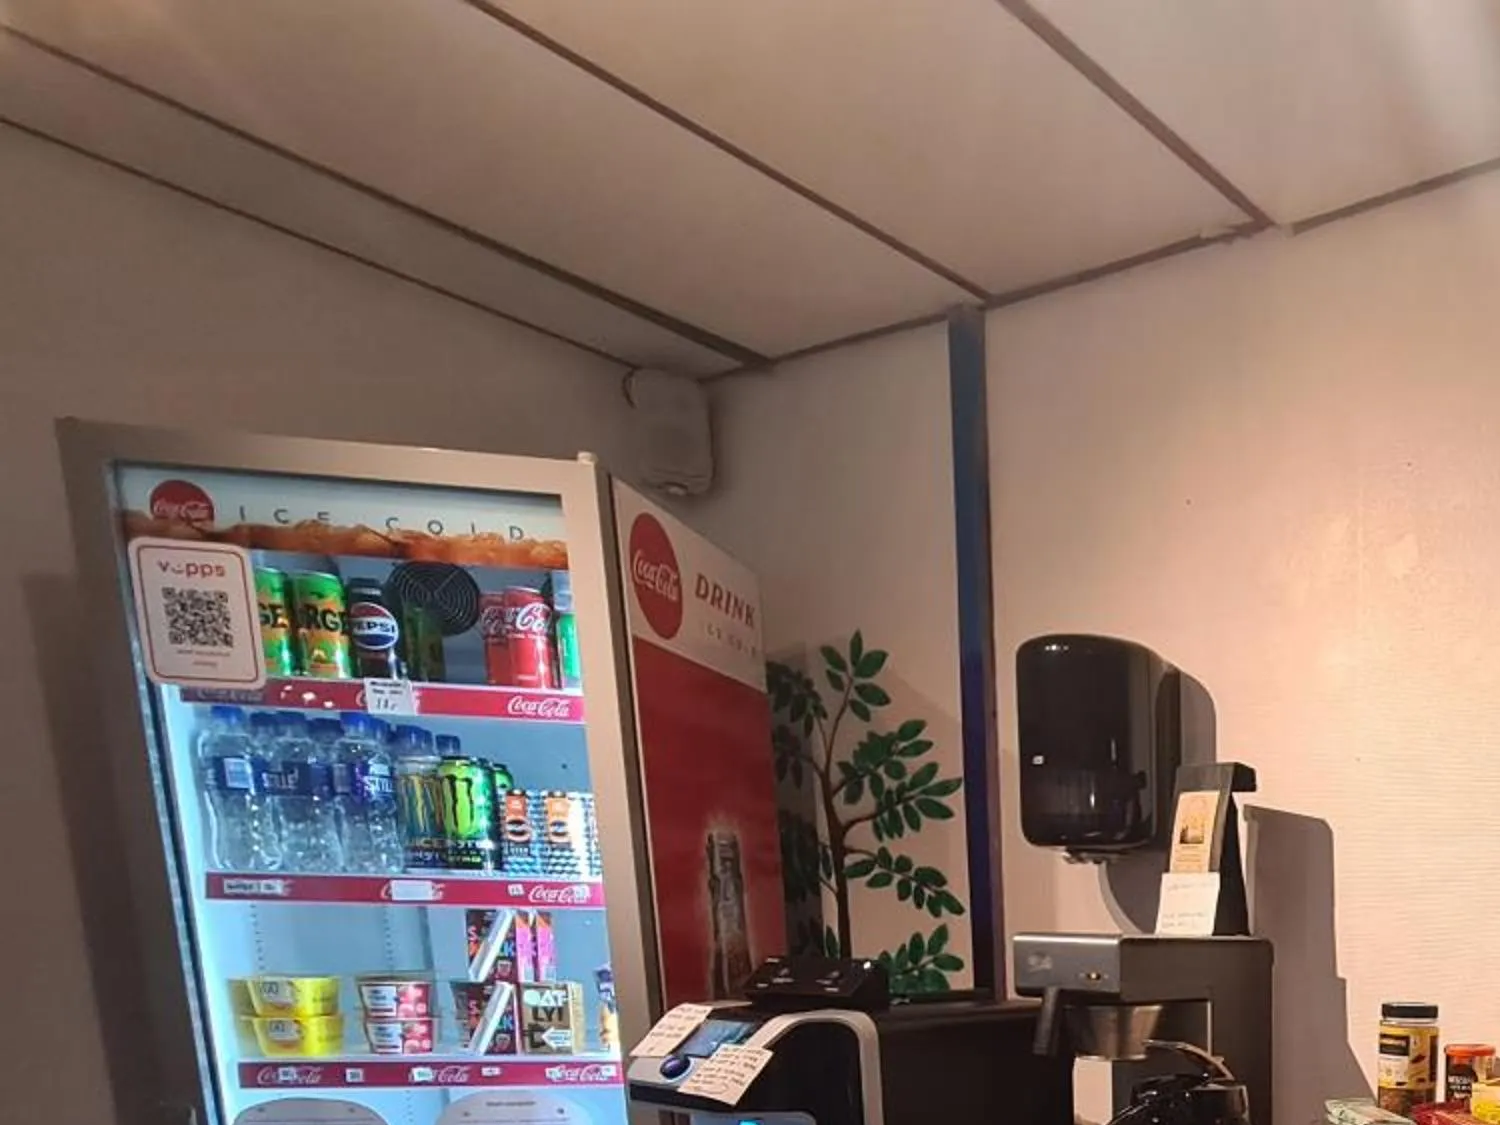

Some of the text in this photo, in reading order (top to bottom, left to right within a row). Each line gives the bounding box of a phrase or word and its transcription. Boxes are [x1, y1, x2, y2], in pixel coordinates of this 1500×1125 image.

[239, 505, 330, 524] ICE
[695, 573, 757, 629] DRINK
[507, 695, 570, 718] Coca-Cola
[528, 884, 592, 904] Coca-Co
